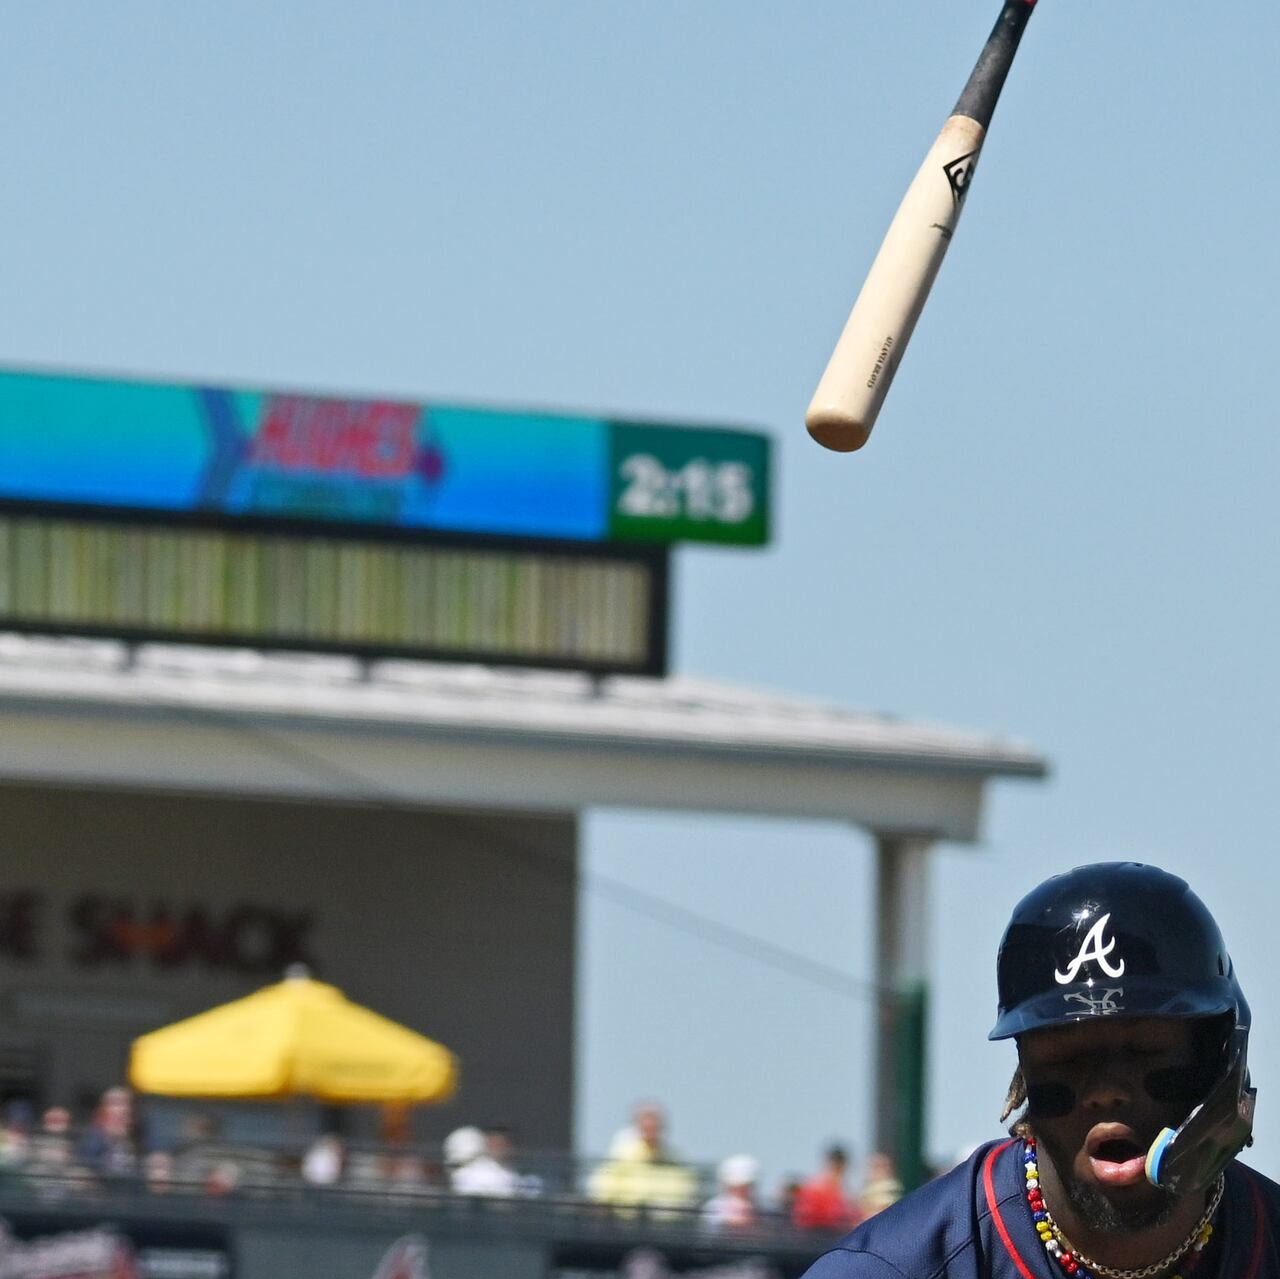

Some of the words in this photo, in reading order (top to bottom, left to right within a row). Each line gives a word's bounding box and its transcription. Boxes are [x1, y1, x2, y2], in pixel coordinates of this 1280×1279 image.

[618, 453, 754, 525] 2:15
[65, 892, 317, 974] SHACK
[1055, 912, 1125, 985] A
